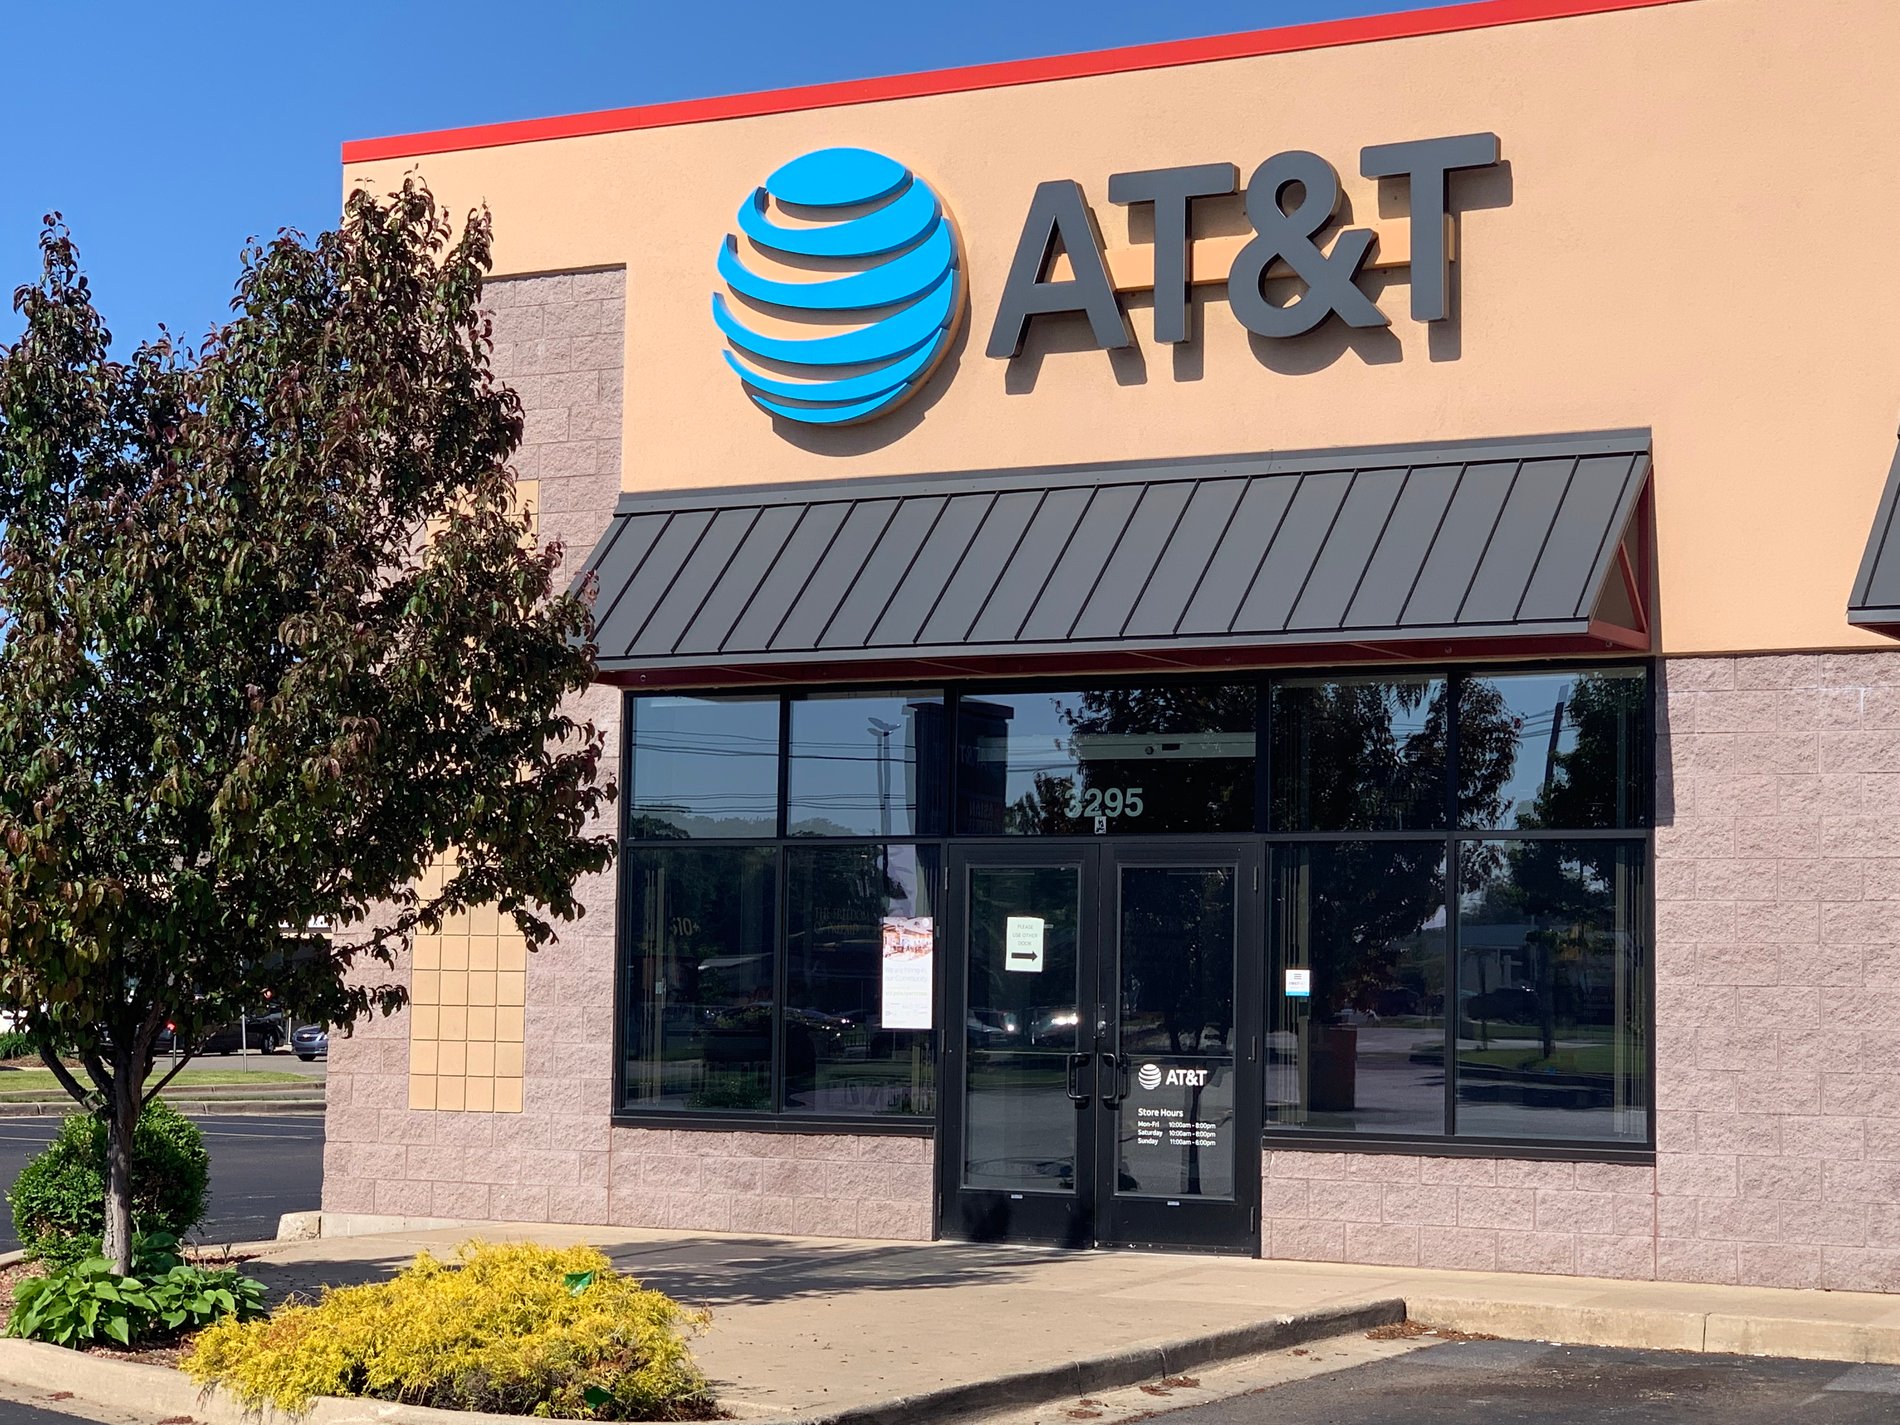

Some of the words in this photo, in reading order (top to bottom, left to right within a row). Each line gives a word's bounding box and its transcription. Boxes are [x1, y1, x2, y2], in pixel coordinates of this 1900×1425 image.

[986, 132, 1502, 359] AT&T
[1063, 787, 1144, 818] 3295
[1165, 1069, 1208, 1087] AT&T
[1137, 1107, 1159, 1117] Store
[1160, 1108, 1184, 1118] Hours
[1137, 1129, 1163, 1138] Saturday
[1137, 1138, 1159, 1146] Sunday
